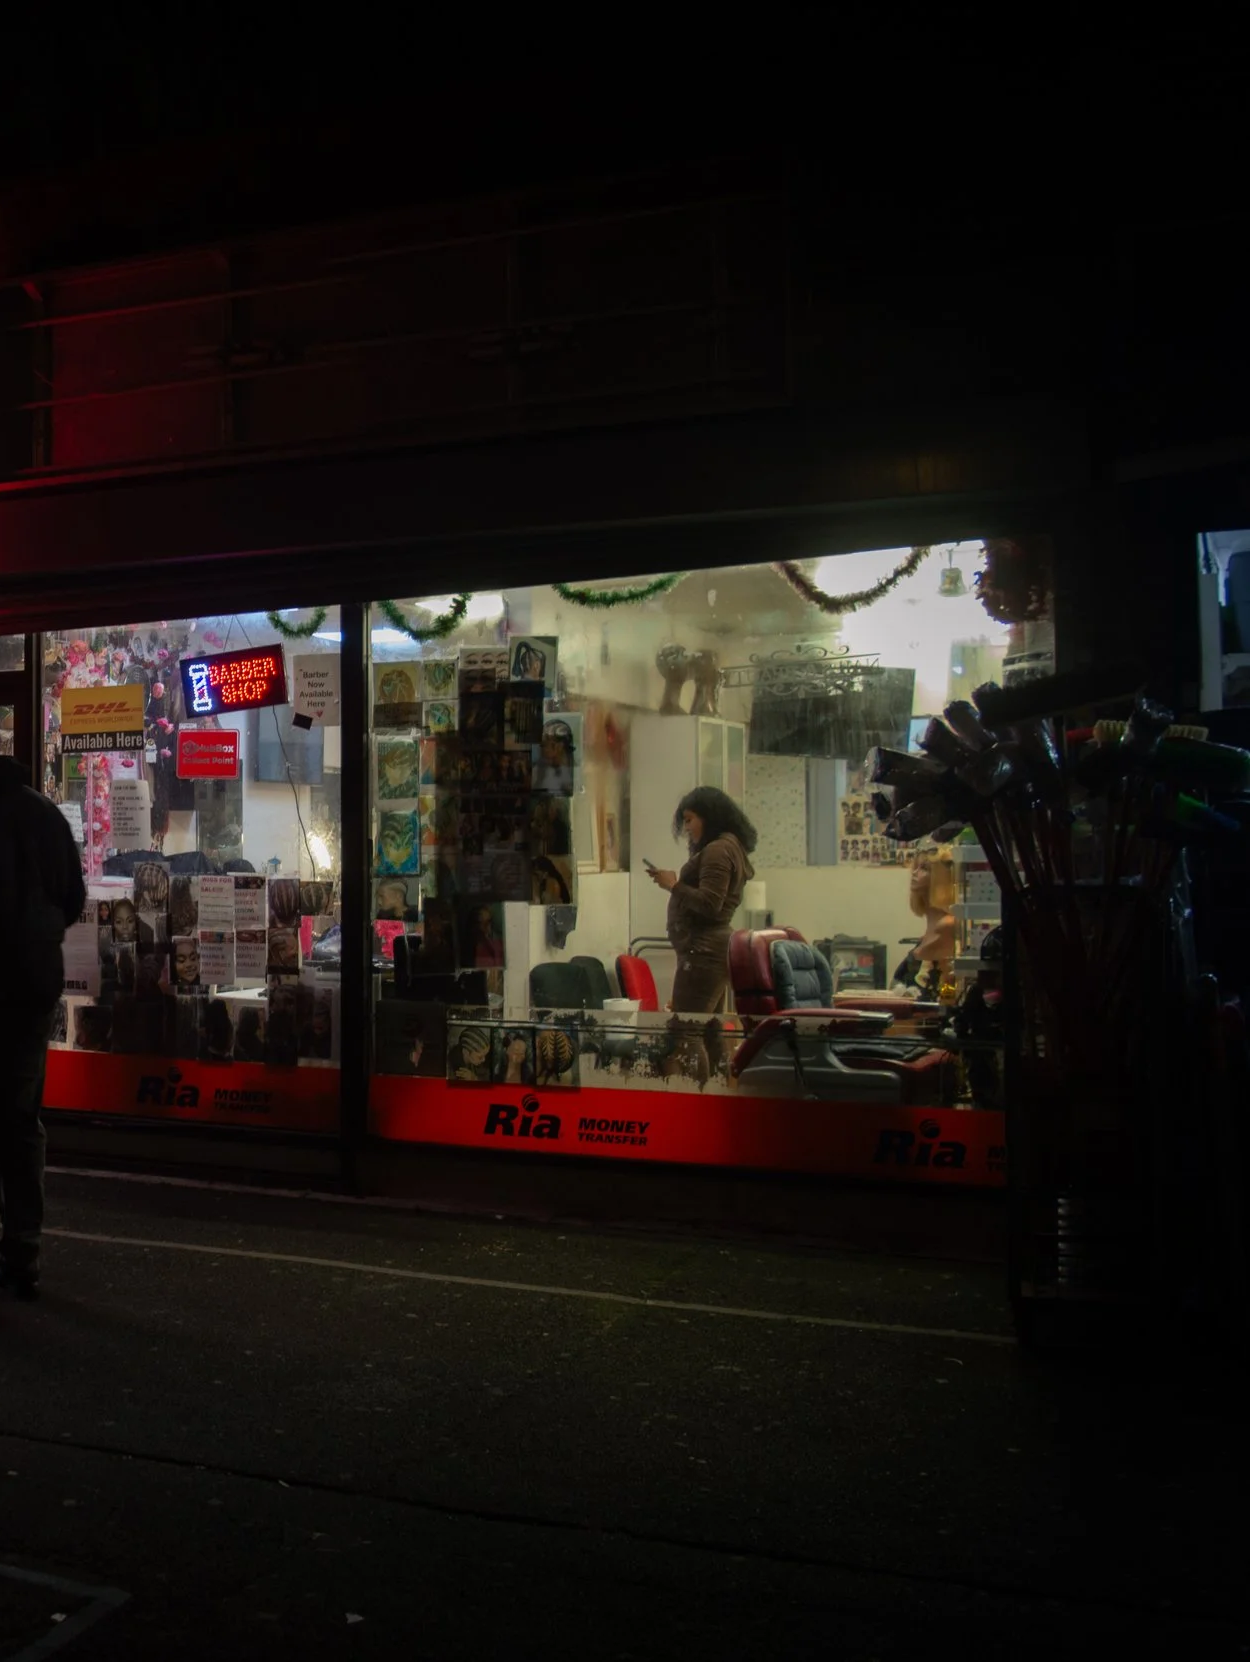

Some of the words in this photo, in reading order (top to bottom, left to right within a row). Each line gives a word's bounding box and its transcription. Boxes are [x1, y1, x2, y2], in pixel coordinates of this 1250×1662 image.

[207, 656, 276, 687] BARBER
[302, 670, 329, 680] Barber
[307, 680, 325, 689] Now
[221, 680, 267, 704] SHOP
[299, 689, 334, 698] Available
[72, 701, 131, 715] DHL
[307, 700, 326, 708] Here
[64, 733, 113, 750] Available
[116, 732, 142, 747] Here
[212, 757, 234, 765] Point
[137, 1066, 199, 1108] Ria
[214, 1087, 272, 1103] MONEY
[484, 1094, 561, 1139] Ria
[578, 1117, 651, 1134] MONEY
[578, 1133, 648, 1146] TRANSFER
[873, 1119, 966, 1169] Ria
